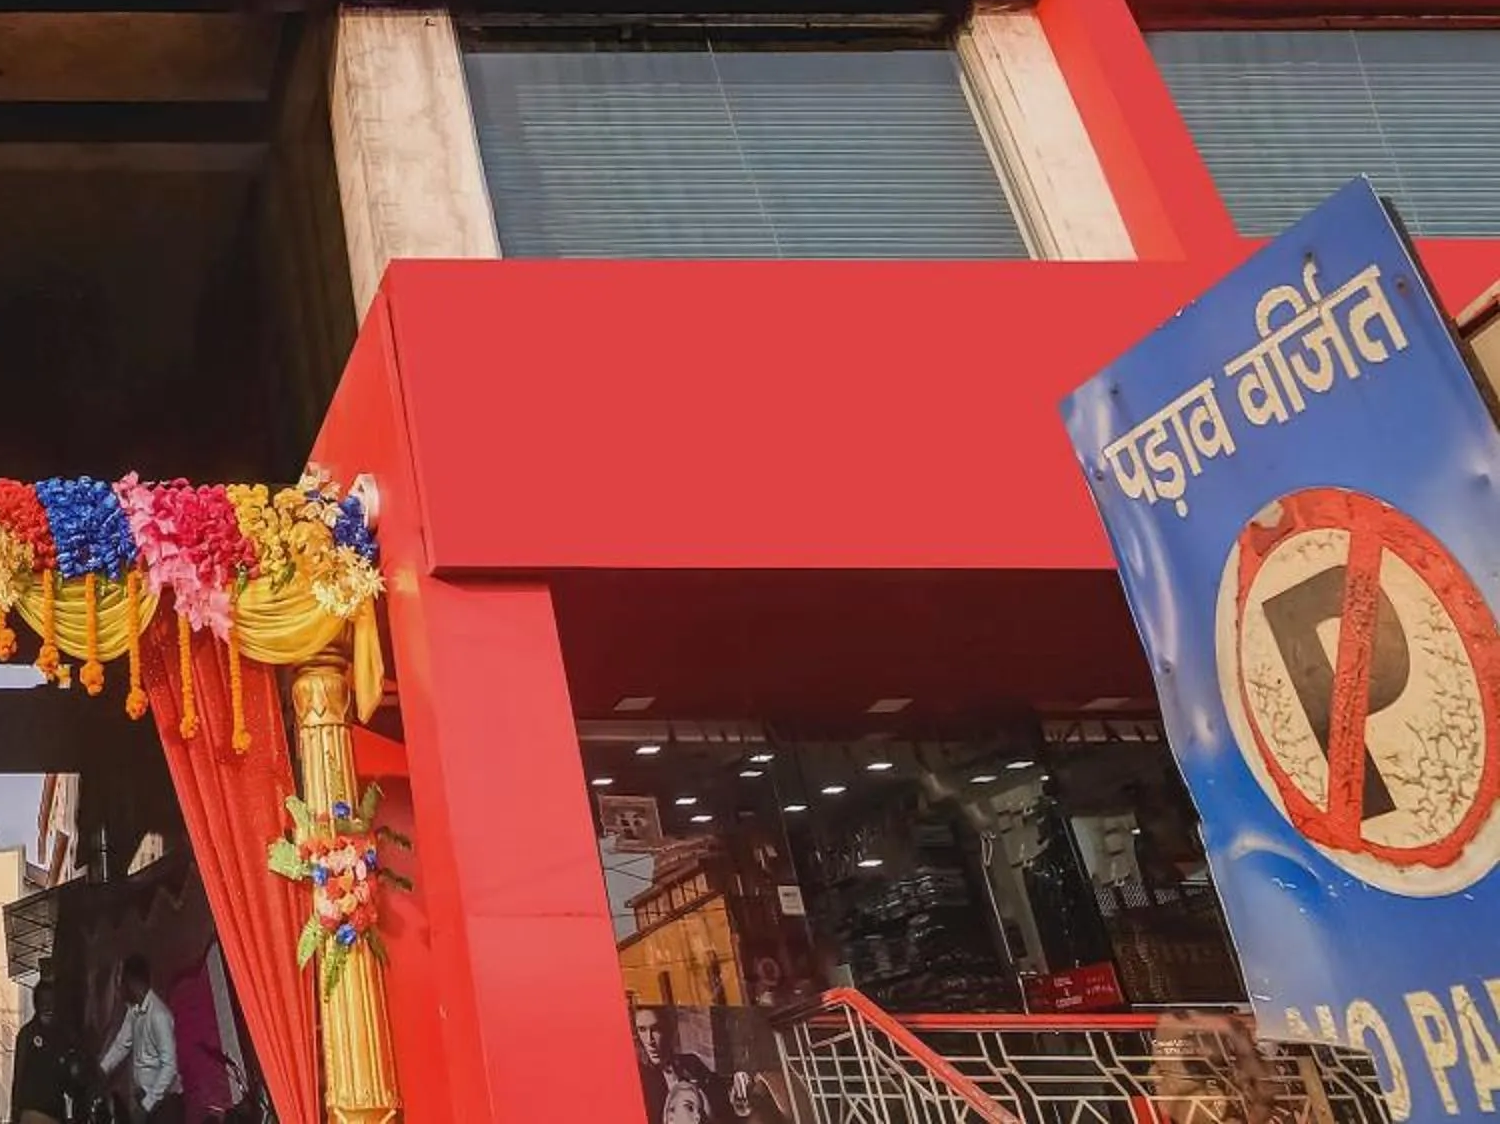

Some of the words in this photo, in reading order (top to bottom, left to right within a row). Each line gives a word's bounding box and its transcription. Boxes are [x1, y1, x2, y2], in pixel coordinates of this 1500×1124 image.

[1102, 378, 1237, 517] पड़ाव
[1224, 261, 1408, 425] वर्जित
[1284, 999, 1412, 1122] O
[1404, 978, 1500, 1115] PA
